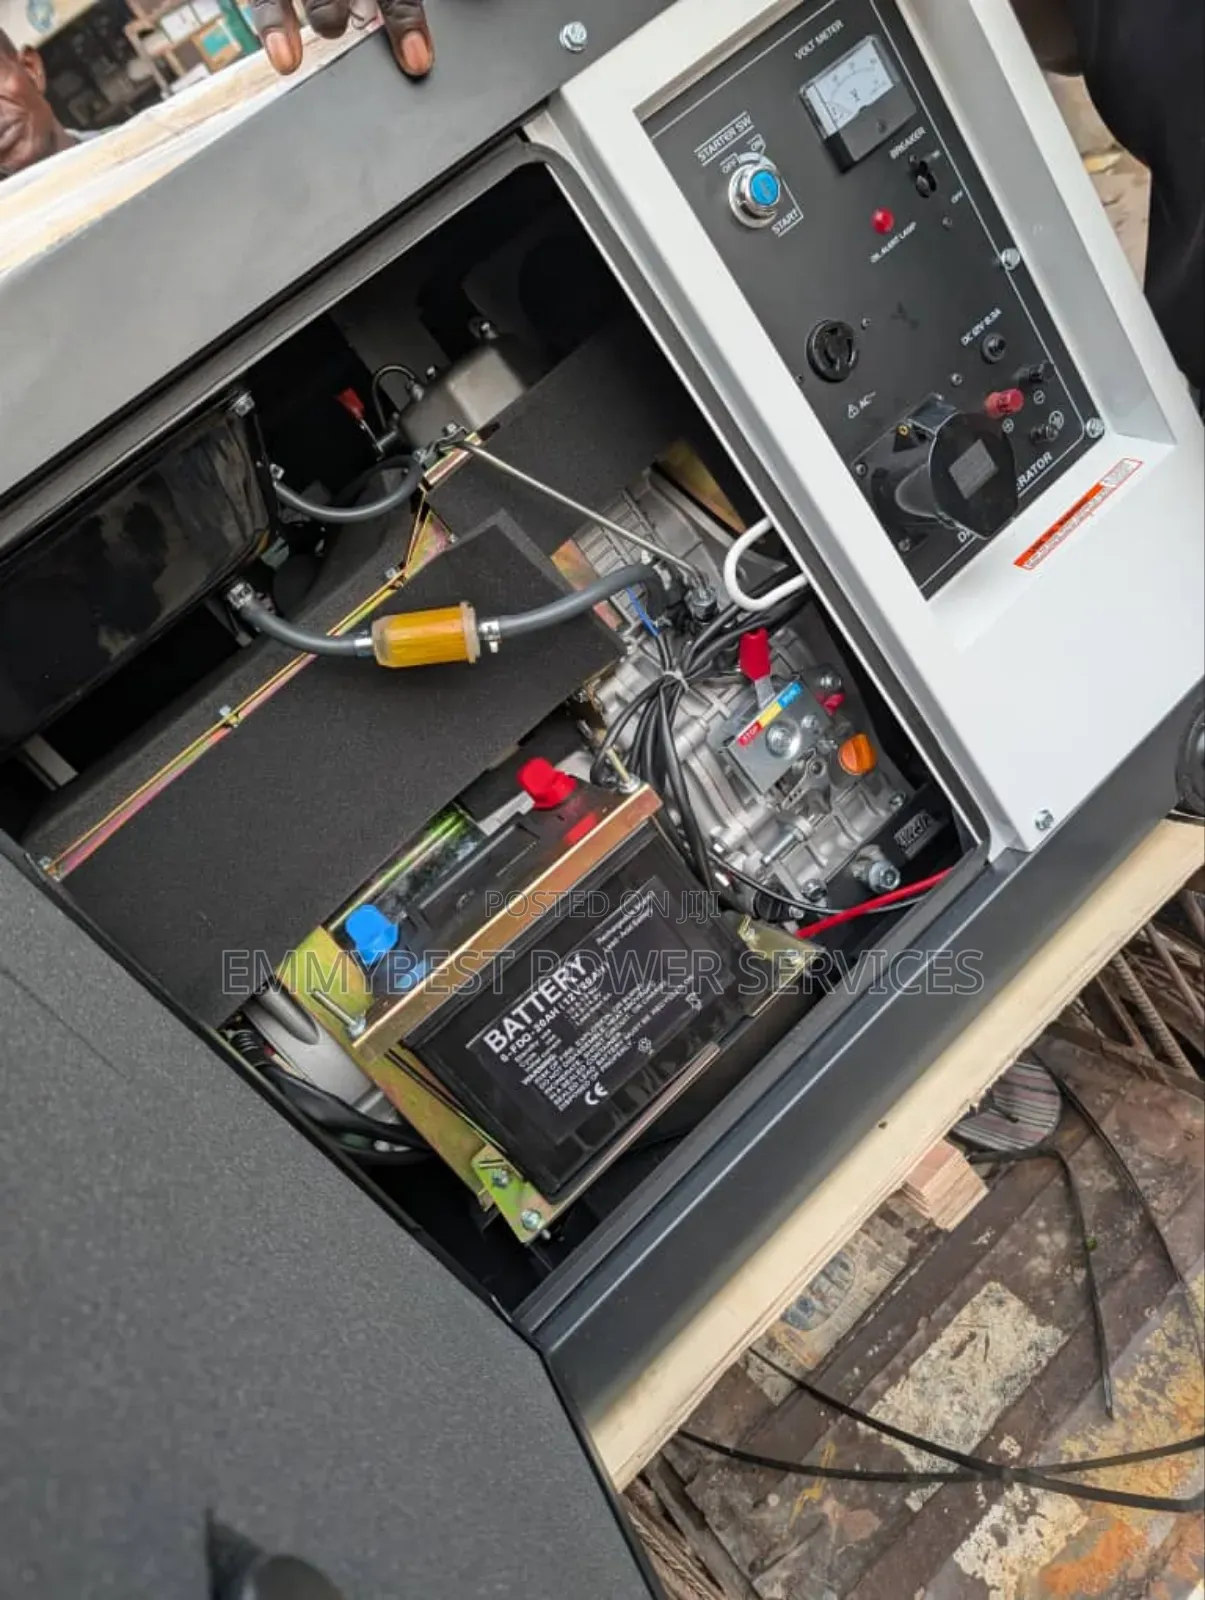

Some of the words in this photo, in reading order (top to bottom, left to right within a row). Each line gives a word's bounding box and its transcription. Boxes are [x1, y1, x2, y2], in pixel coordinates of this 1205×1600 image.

[794, 37, 816, 60] VOLT
[814, 19, 844, 45] METER
[697, 129, 737, 161] STARTER
[735, 115, 752, 133] SW
[889, 126, 926, 160] BREAKER
[722, 159, 739, 174] OFF
[771, 208, 799, 235] START
[483, 953, 587, 1053] BATTERY
